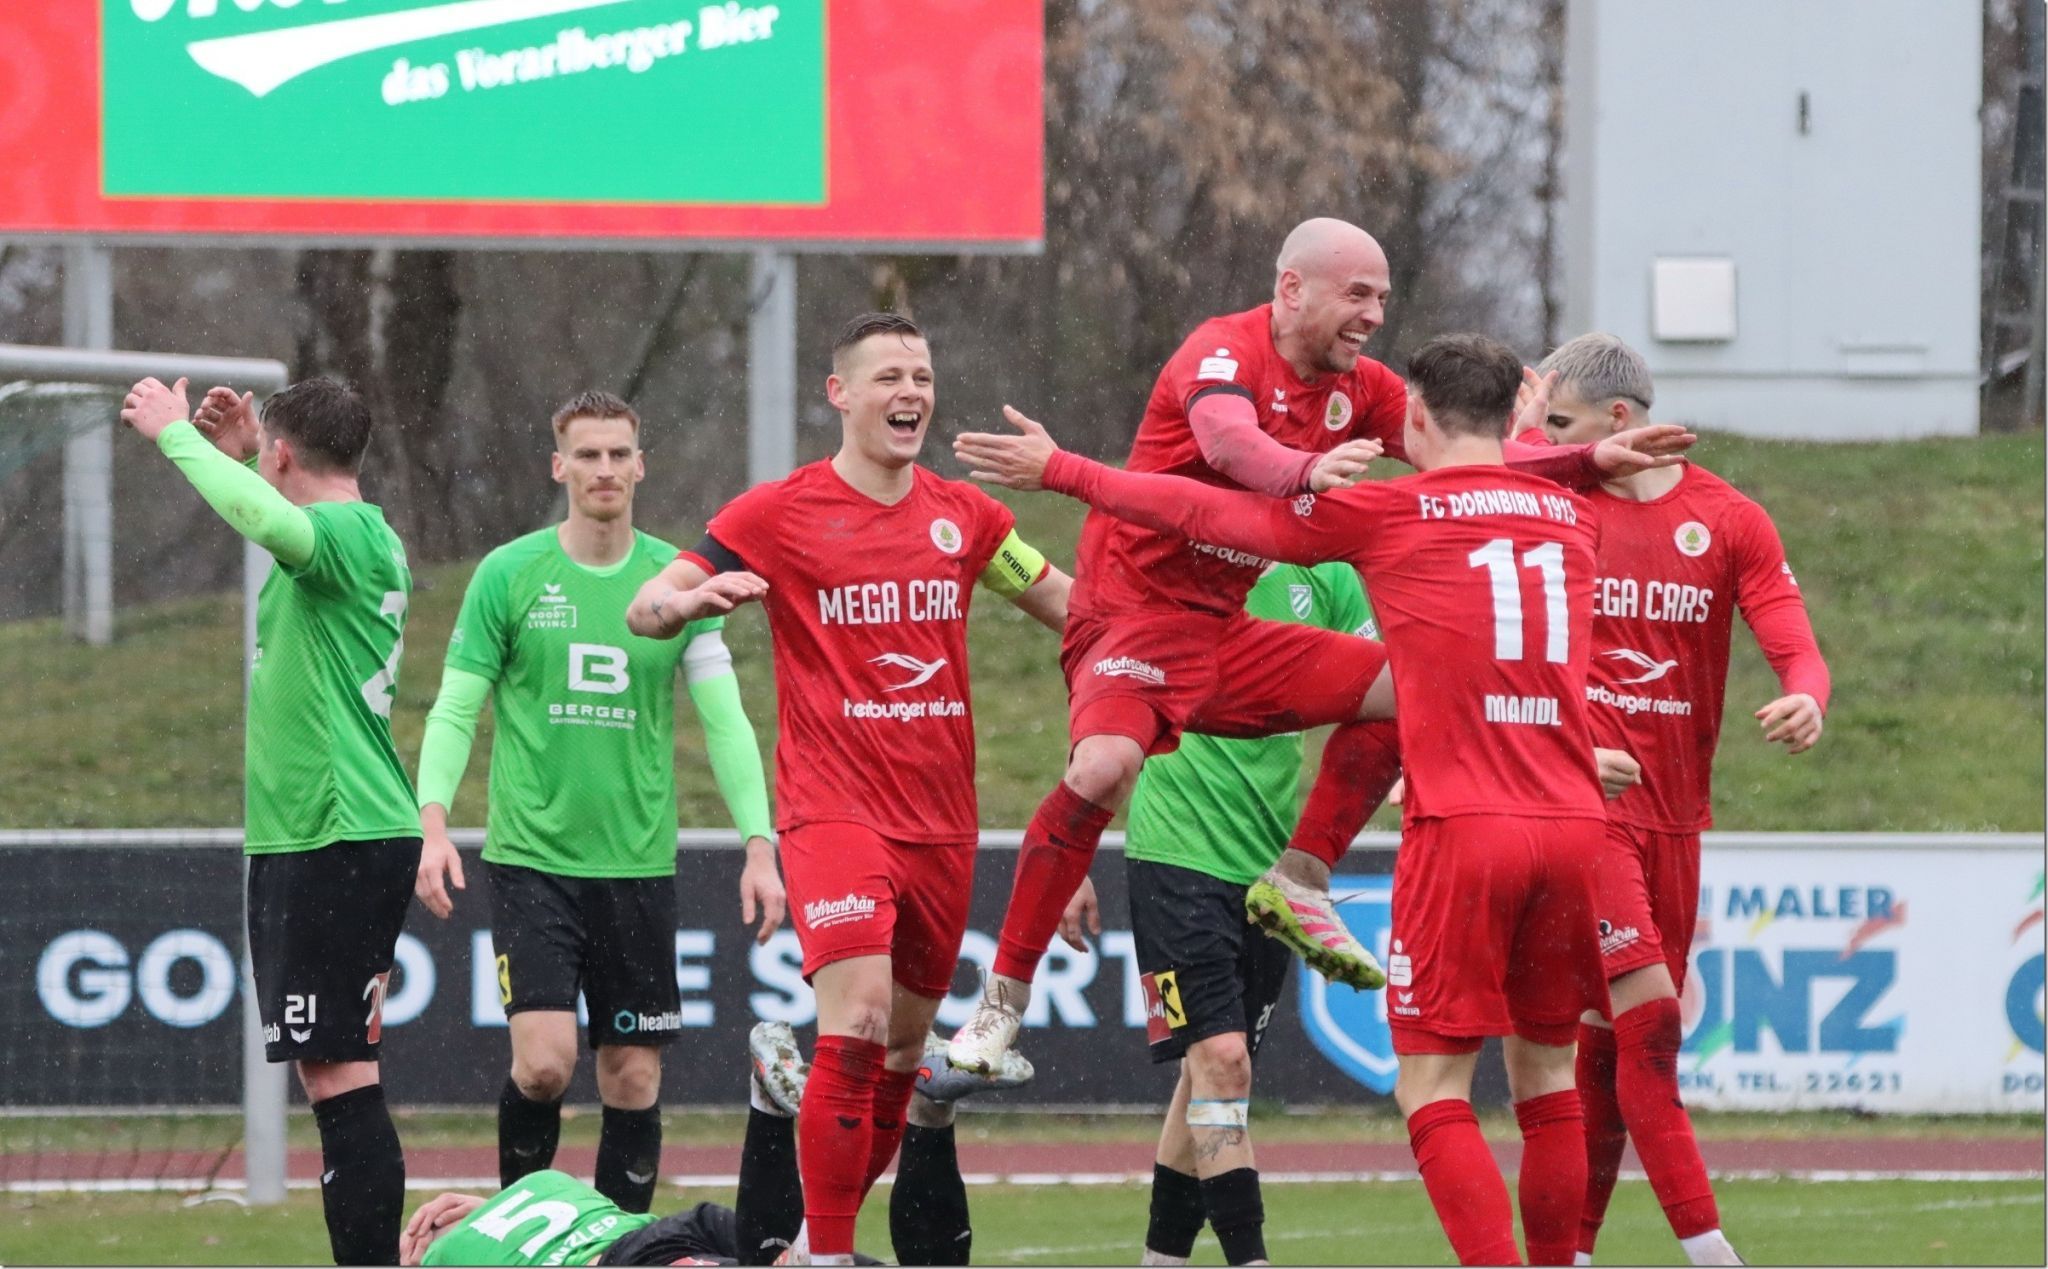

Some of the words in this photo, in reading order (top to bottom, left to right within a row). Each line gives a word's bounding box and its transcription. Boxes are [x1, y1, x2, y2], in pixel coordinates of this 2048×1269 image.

[381, 58, 449, 105] das
[455, 20, 693, 91] Vorarlberger
[697, 1, 780, 50] Bier
[1418, 494, 1445, 520] FC
[1448, 489, 1542, 517] DORNBIRN
[1542, 494, 1577, 526] 1913
[1002, 550, 1030, 583] erima
[818, 581, 900, 625] MEGA
[909, 579, 962, 622] CAR
[1468, 539, 1569, 664] 11
[1593, 577, 1639, 619] EGA
[1645, 580, 1714, 624] CARS
[528, 620, 568, 629] LIVING
[549, 704, 637, 721] BERGER
[844, 698, 927, 722] herburger
[1485, 695, 1562, 726] MANDL
[1726, 885, 1895, 920] MALER
[285, 994, 316, 1024] 21
[468, 1187, 579, 1259] 5
